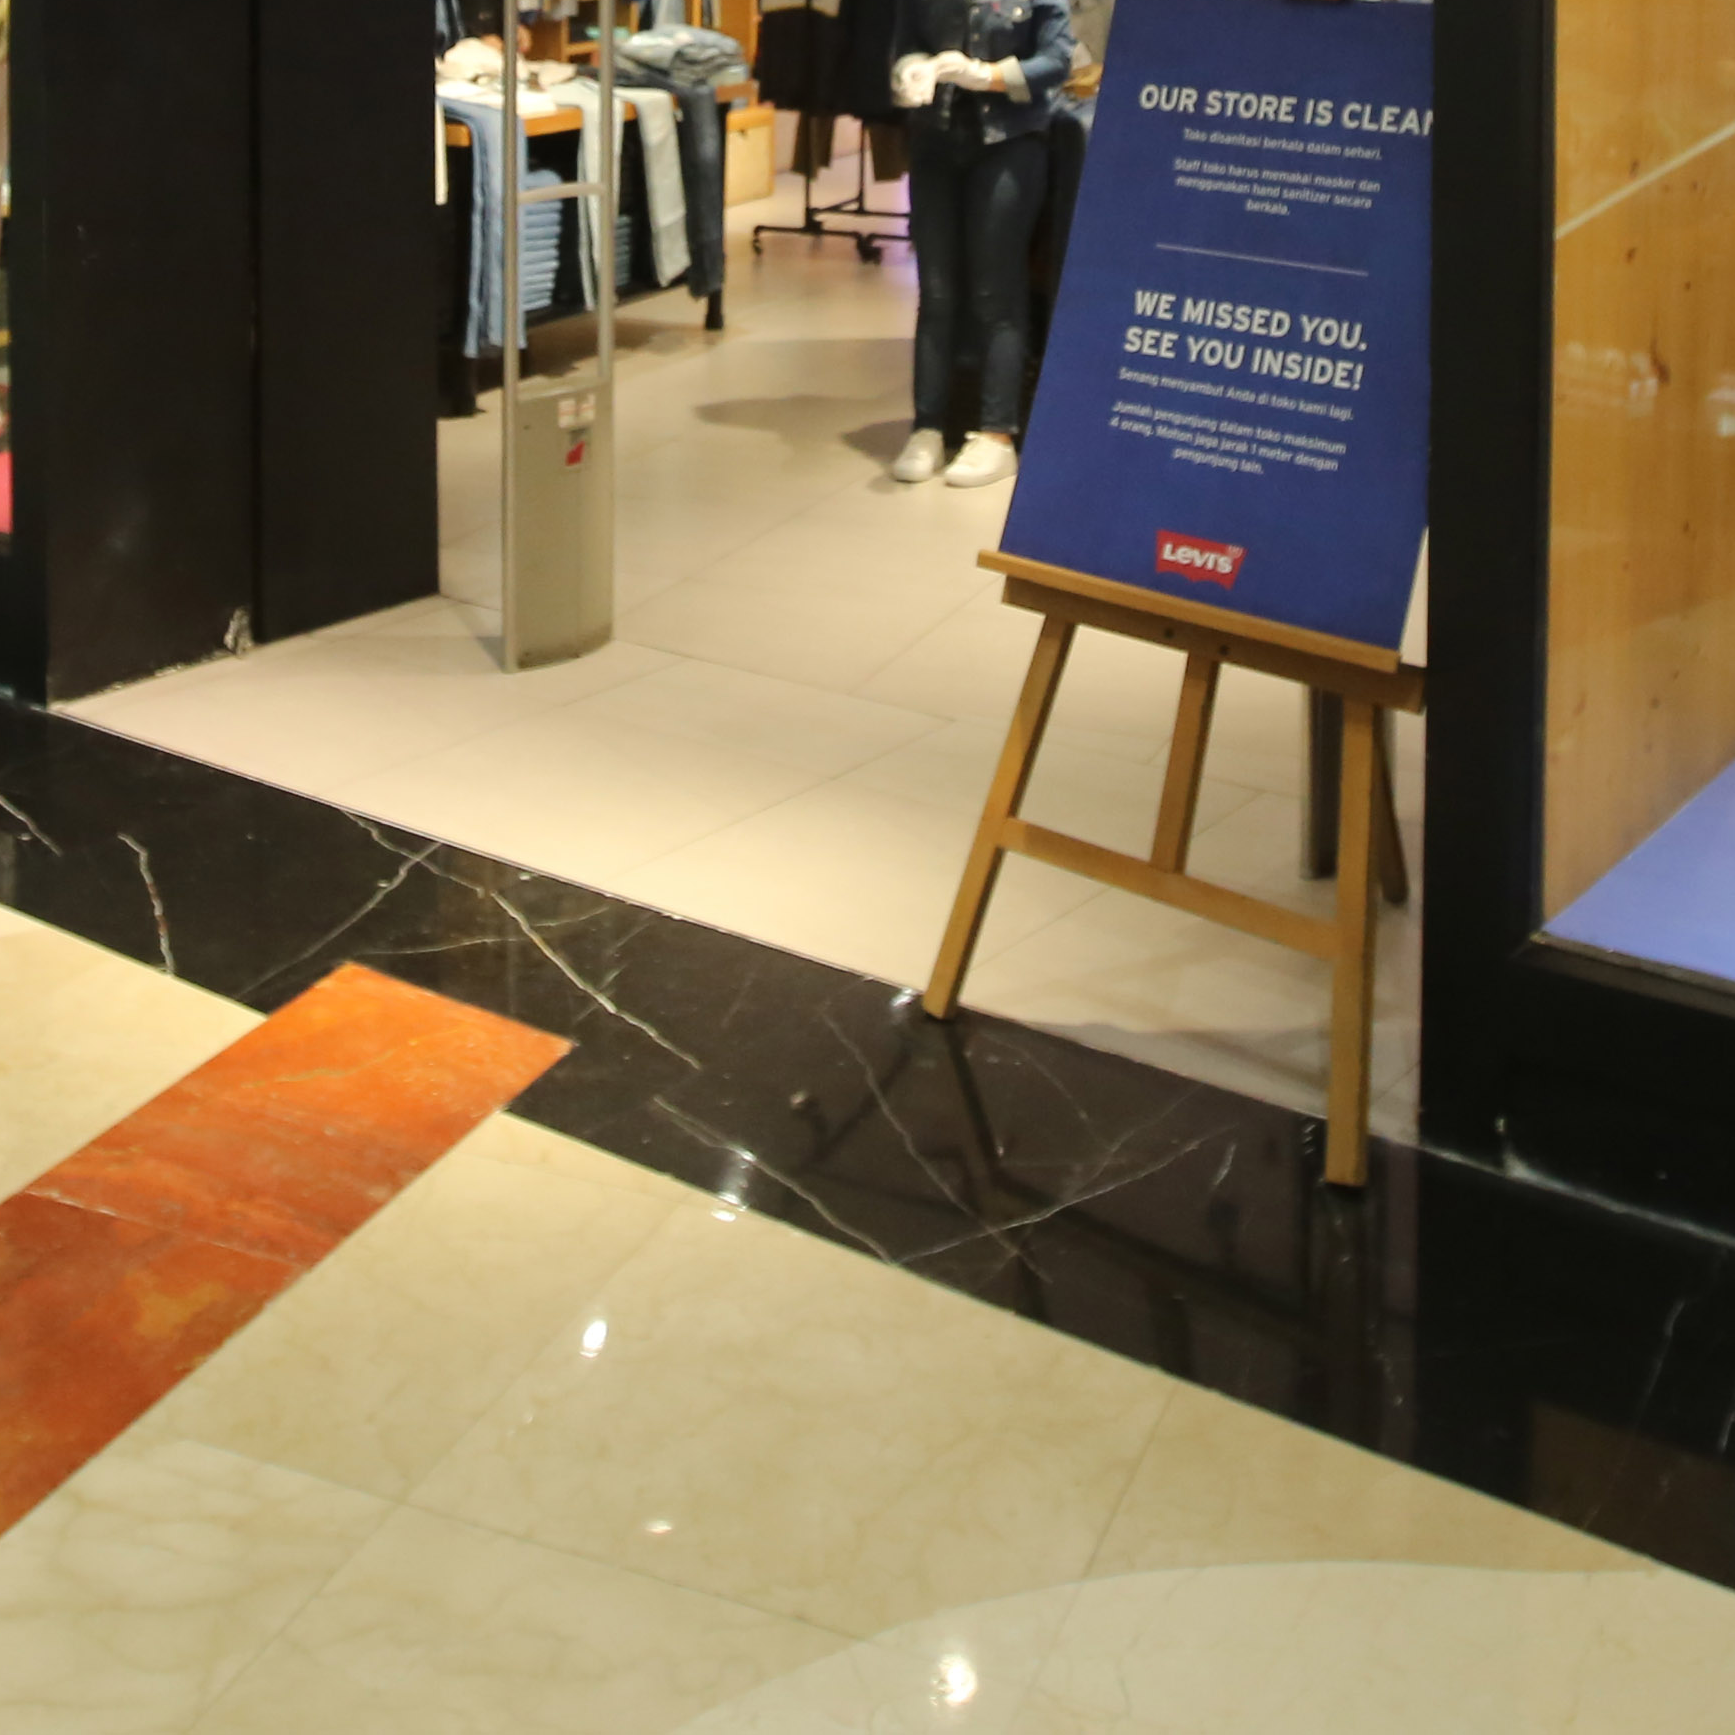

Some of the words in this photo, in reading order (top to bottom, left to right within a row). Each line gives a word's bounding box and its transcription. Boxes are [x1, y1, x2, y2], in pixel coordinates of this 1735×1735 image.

[1139, 84, 1198, 113] OUR
[1205, 91, 1297, 122] STORE
[1304, 99, 1334, 126] IS
[1183, 127, 1207, 142] Toko
[1307, 142, 1341, 156] dalam
[1174, 158, 1200, 171] Staff
[1203, 161, 1226, 174] toko
[1229, 164, 1259, 178] harus
[1262, 168, 1312, 184] memakai
[1315, 174, 1356, 190] masker
[1358, 178, 1381, 192] dan
[1175, 175, 1250, 194] menggunakan
[1252, 184, 1280, 198] hand
[1283, 187, 1331, 204] sanitizer
[1333, 194, 1372, 209] secara
[1133, 290, 1177, 321] WE
[1182, 297, 1291, 338] MISSED
[1300, 314, 1367, 352] YOU.
[1123, 325, 1179, 359] SEE
[1186, 336, 1245, 370] YOU
[1250, 347, 1364, 391] INSIDE!
[1160, 376, 1224, 398] menyambut
[1226, 386, 1256, 404] Anda
[1257, 391, 1269, 405] di
[1271, 395, 1297, 411] toko
[1298, 399, 1327, 416] kami
[1112, 401, 1153, 418] Jumlah
[1153, 409, 1218, 433] pengunjung
[1219, 419, 1254, 437] dalam
[1256, 426, 1281, 442] toko
[1283, 432, 1346, 454] maksimum
[1156, 425, 1193, 442] Mohon
[1195, 433, 1219, 450] jaga
[1220, 437, 1250, 454] jarak
[1259, 447, 1292, 463] meter
[1294, 452, 1338, 471] dengan
[1172, 447, 1238, 472] pengunjung
